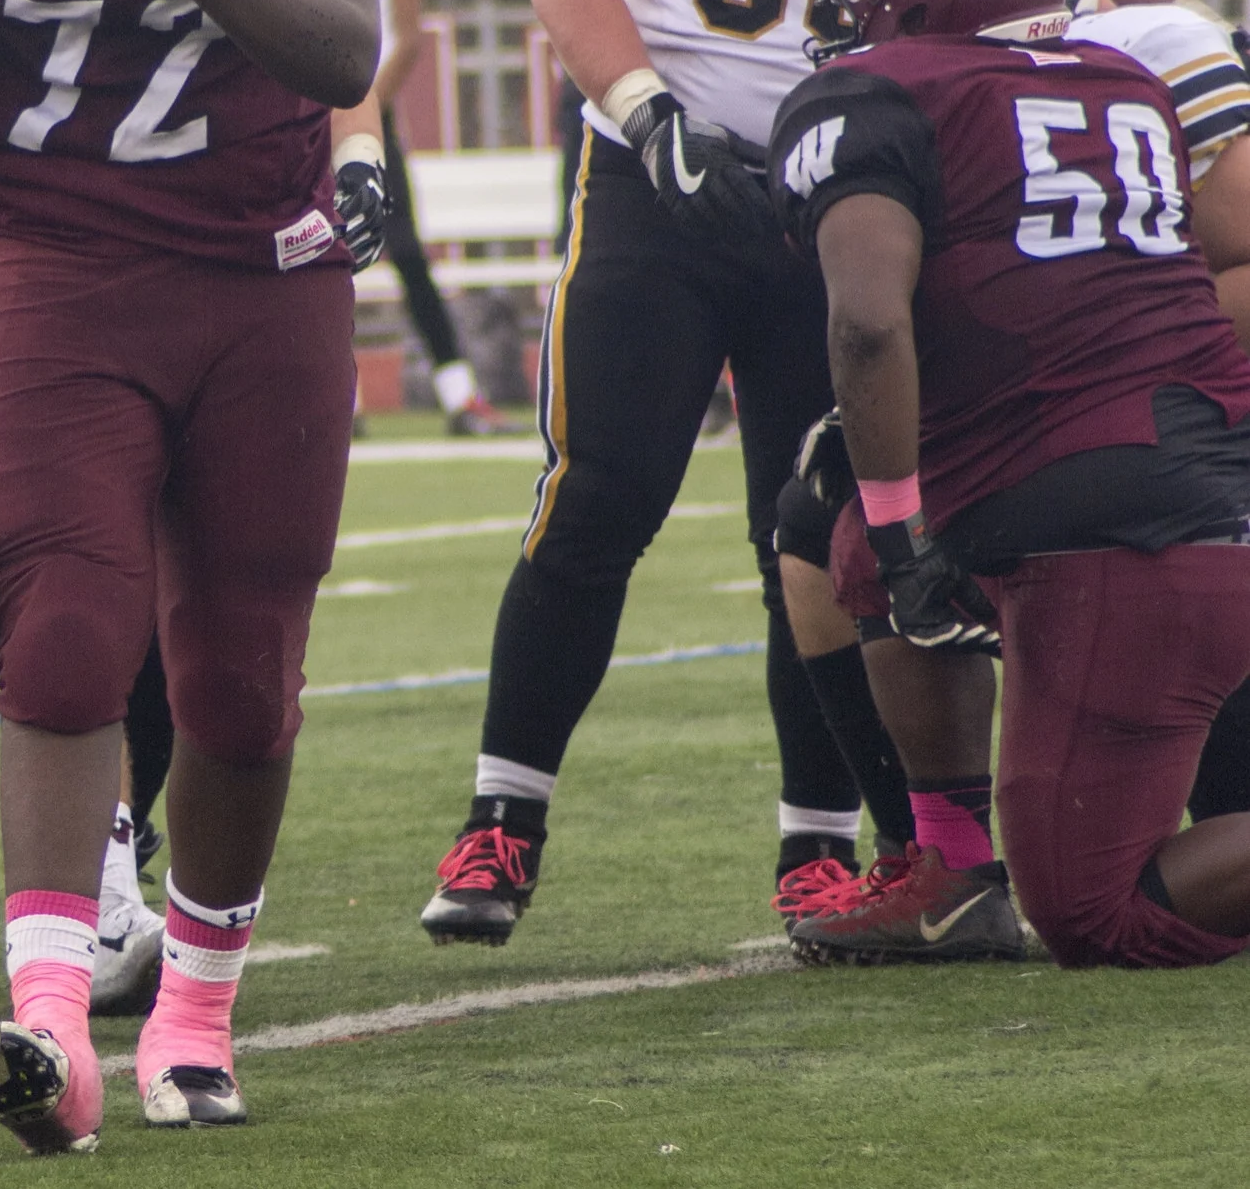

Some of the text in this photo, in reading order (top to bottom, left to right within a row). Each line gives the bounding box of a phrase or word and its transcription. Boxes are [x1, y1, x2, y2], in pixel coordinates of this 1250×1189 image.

[1027, 17, 1071, 40] Ridde
[1014, 97, 1189, 258] 50
[284, 218, 326, 249] Riddell
